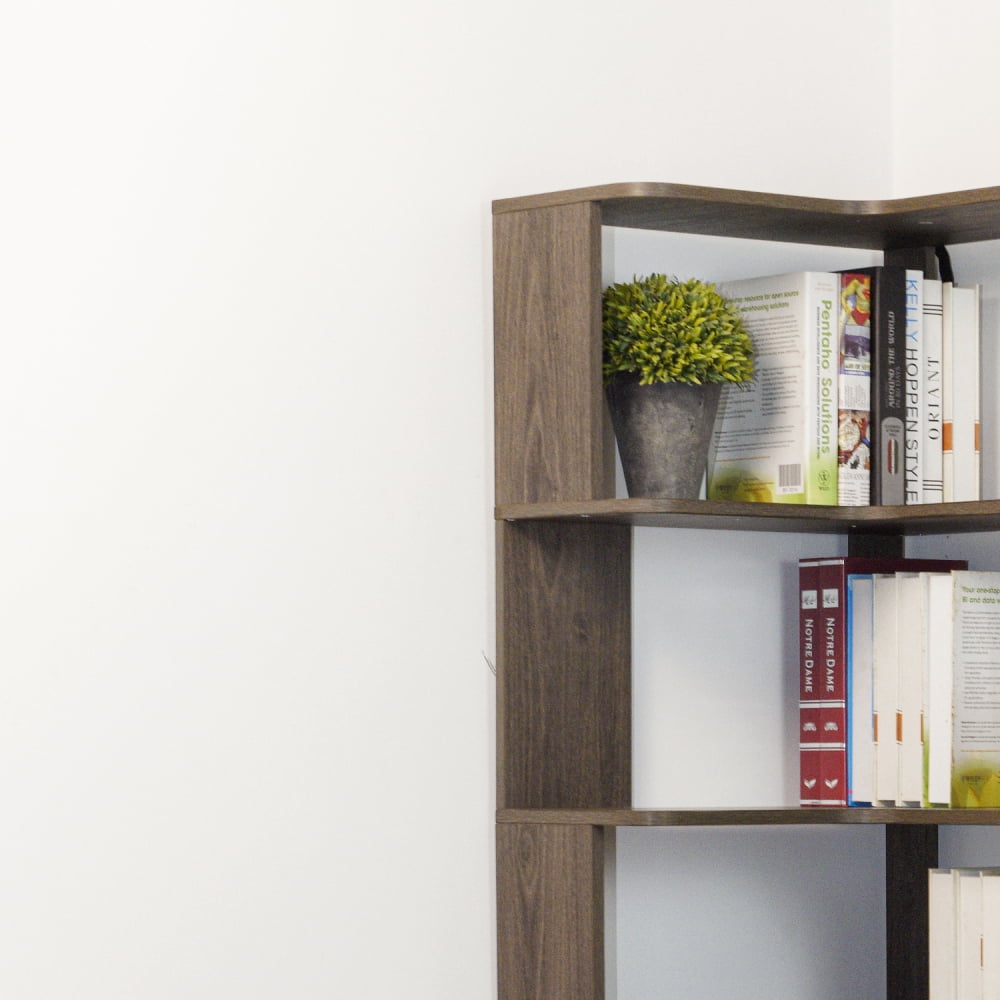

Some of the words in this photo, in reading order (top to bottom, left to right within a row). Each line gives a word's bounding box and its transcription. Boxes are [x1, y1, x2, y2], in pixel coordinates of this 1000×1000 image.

[888, 310, 896, 345] WORLD
[905, 279, 919, 342] KELLY
[821, 299, 832, 369] Pentaho
[888, 347, 896, 365] THE
[906, 348, 919, 433] HOPPEN
[821, 378, 832, 453] Solutions
[906, 439, 919, 502] STYLE
[805, 619, 814, 657] NOTRE
[826, 618, 836, 656] NOTRE
[805, 660, 814, 692] DAME
[826, 659, 836, 692] DAME
